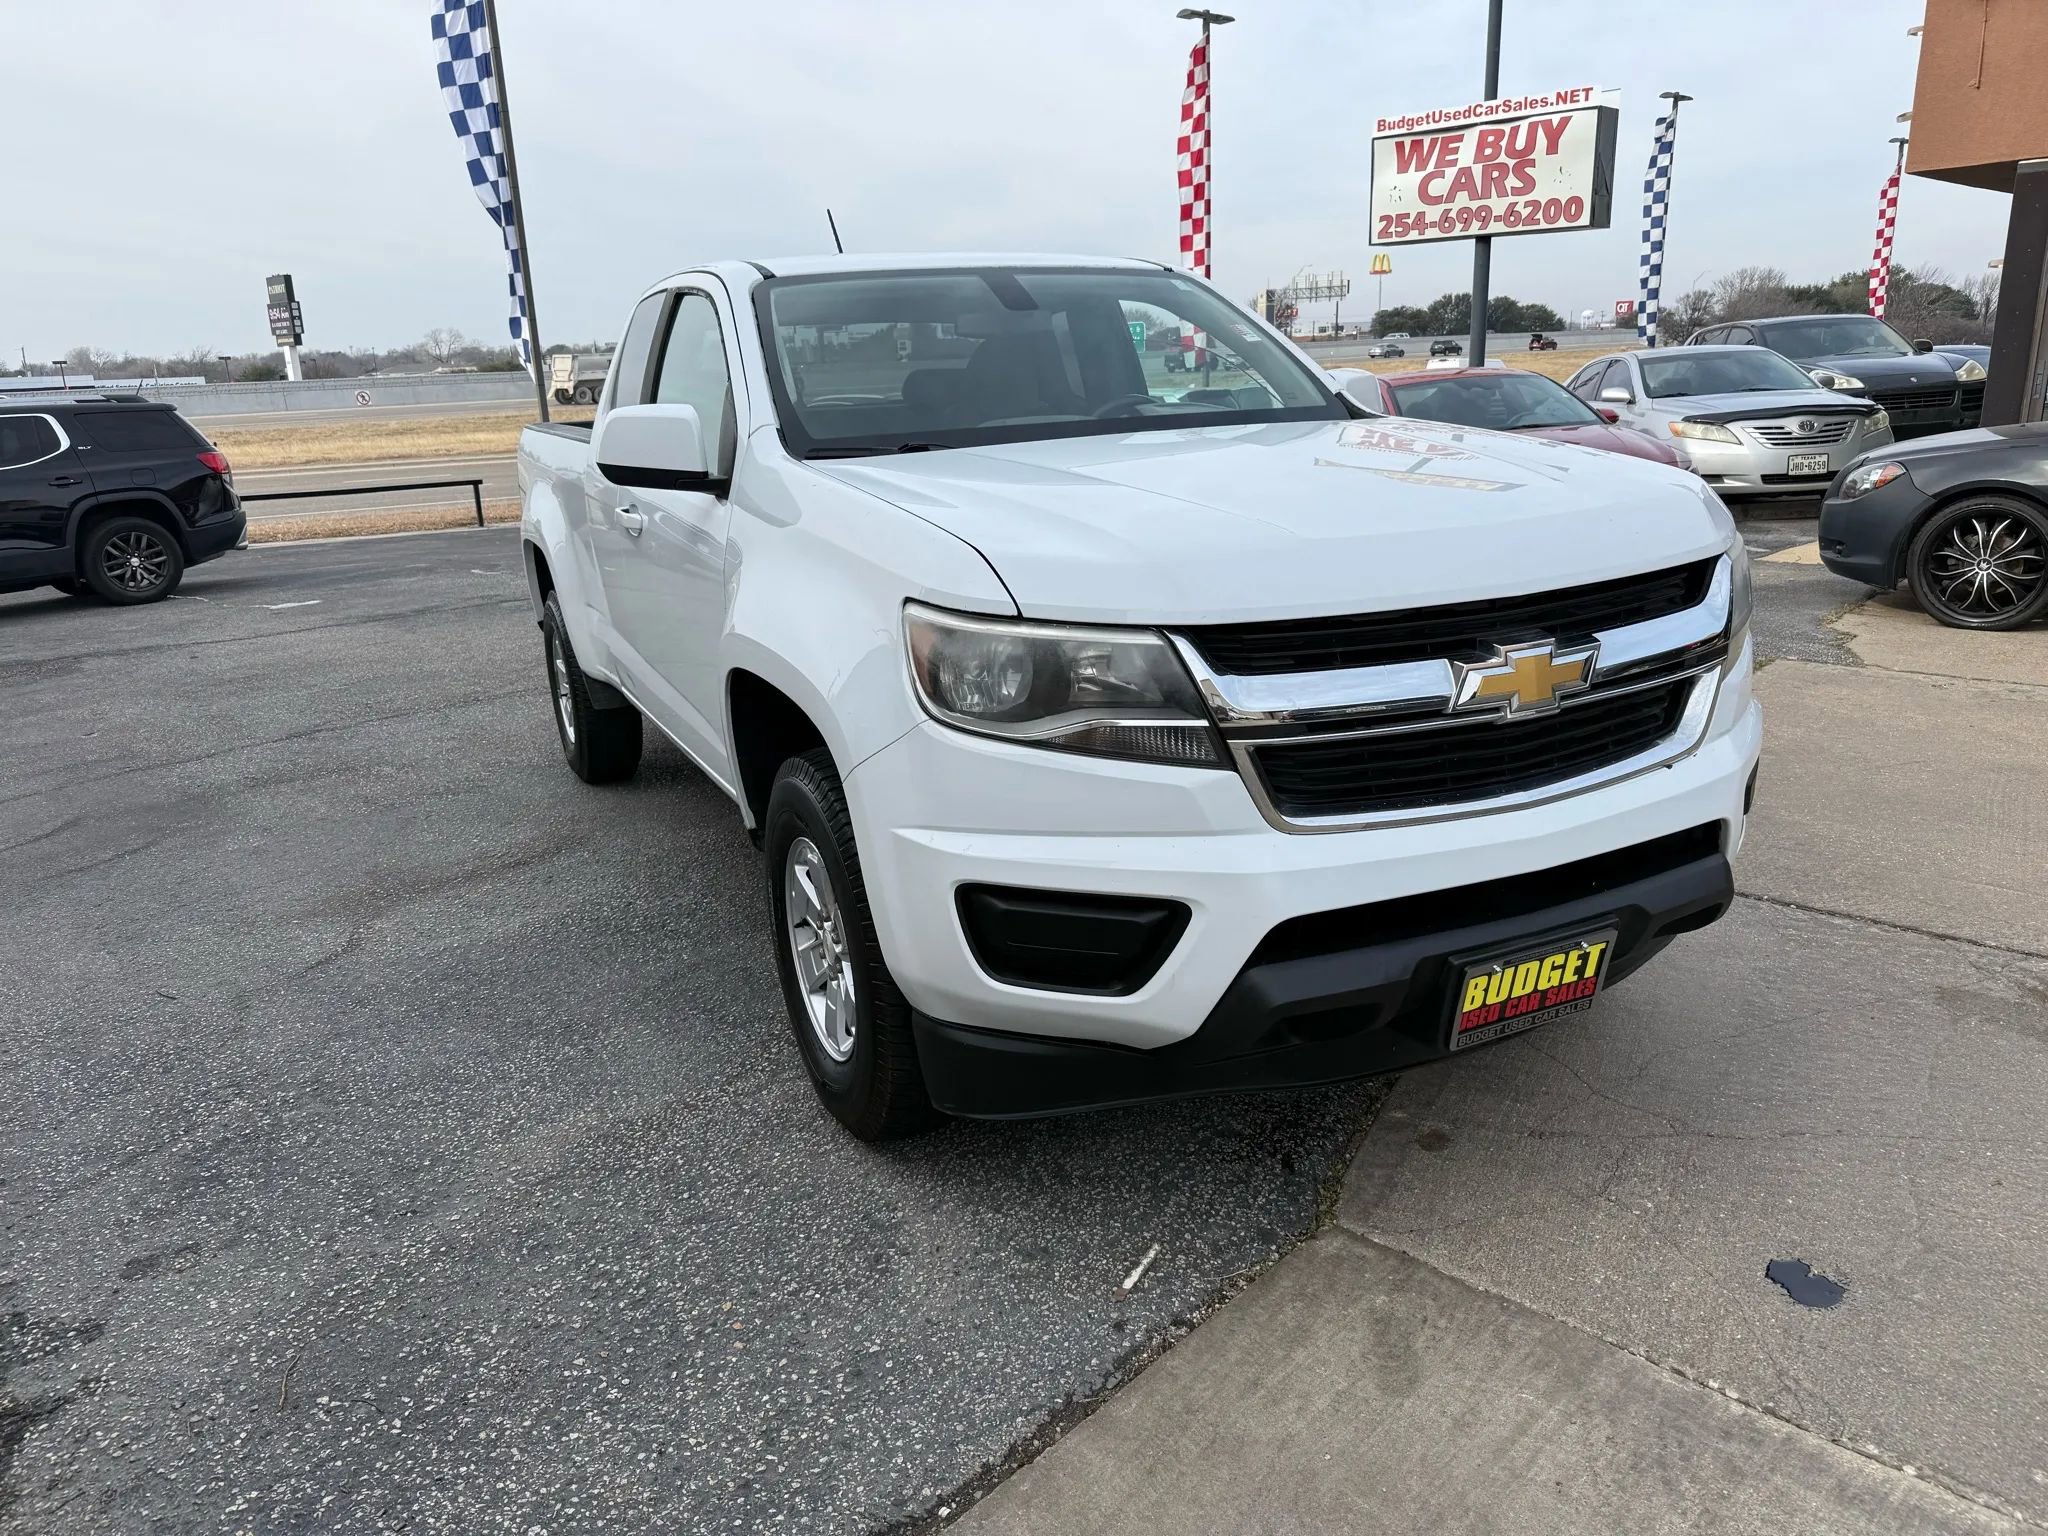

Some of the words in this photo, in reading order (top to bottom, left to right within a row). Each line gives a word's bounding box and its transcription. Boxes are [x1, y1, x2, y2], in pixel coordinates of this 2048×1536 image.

[1376, 87, 1594, 132] BudgetUsedCarSales.NET
[1394, 133, 1465, 175] WE
[1472, 115, 1573, 165] BUY
[1417, 158, 1537, 206] CARS
[1377, 196, 1584, 240] 254-699-6200
[1462, 943, 1608, 1013] BUDGET
[1504, 992, 1540, 1018] CAR
[1544, 976, 1597, 1007] SALES
[1459, 1026, 1503, 1046] BUDGET
[1504, 1017, 1532, 1032] USED
[1535, 1010, 1556, 1023] CAR
[1558, 1000, 1590, 1017] SALES
